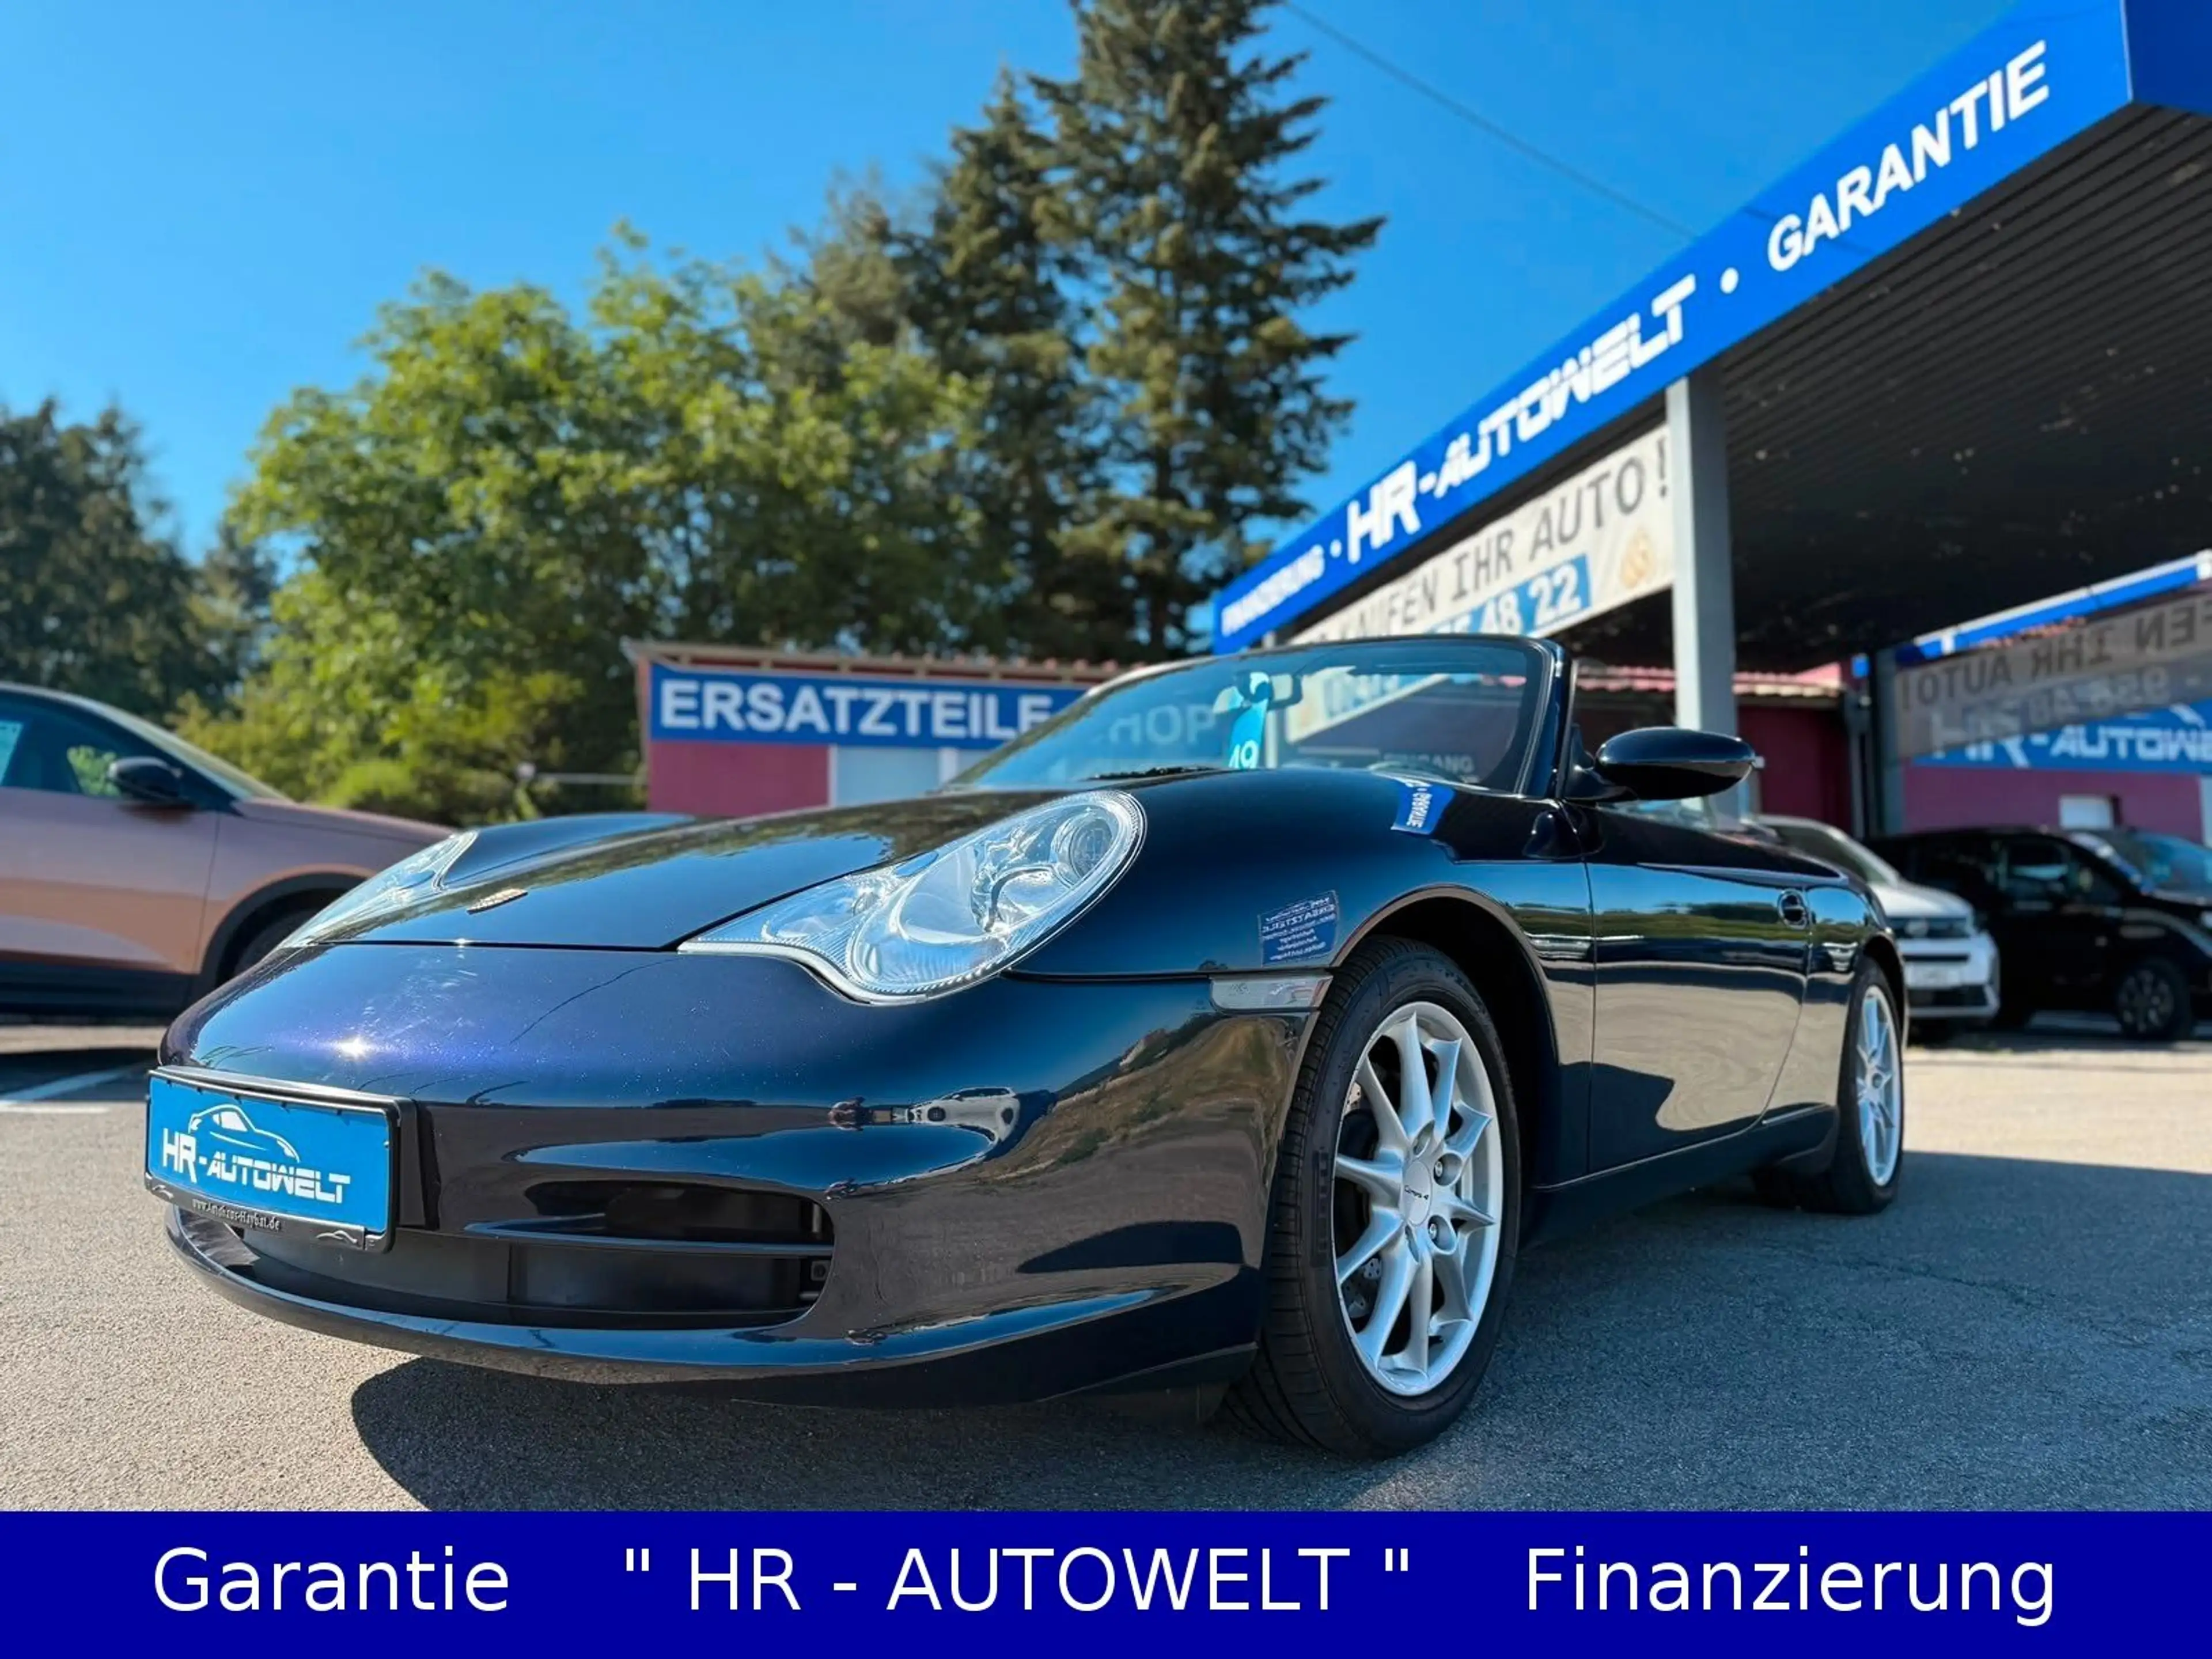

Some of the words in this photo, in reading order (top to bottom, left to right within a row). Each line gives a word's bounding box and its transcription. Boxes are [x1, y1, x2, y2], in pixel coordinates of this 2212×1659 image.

[1347, 272, 1696, 565] HR-AUTOWELT
[1767, 40, 2050, 271] GARANTIE
[1451, 527, 1516, 602] IHR
[1529, 435, 1669, 563] AUTO!
[1528, 563, 1583, 629] 22
[162, 1127, 351, 1204] HR-AUTOWELT
